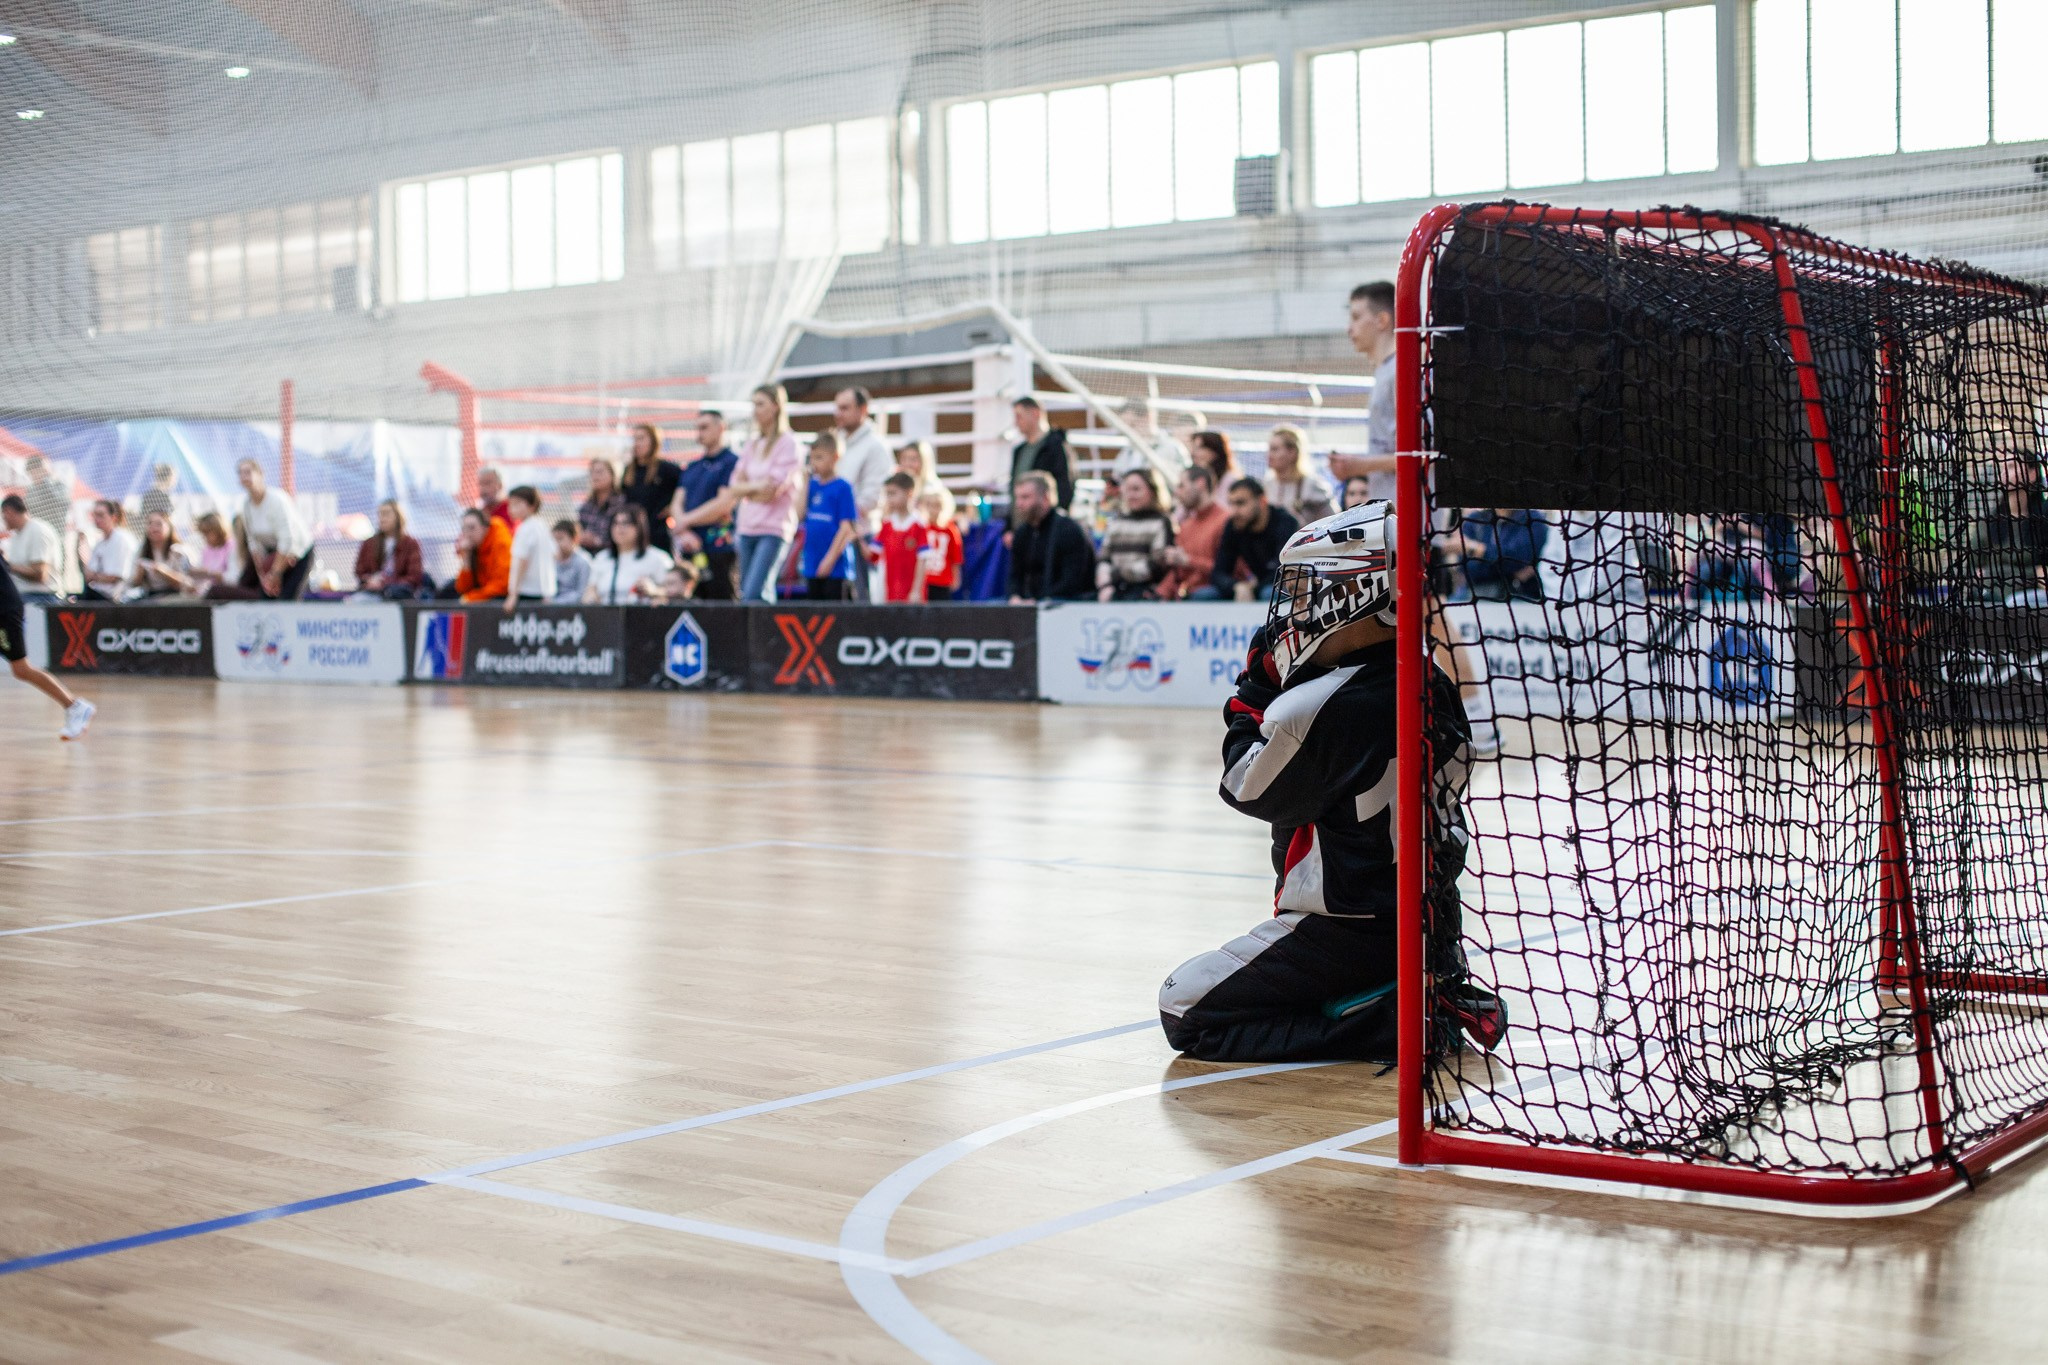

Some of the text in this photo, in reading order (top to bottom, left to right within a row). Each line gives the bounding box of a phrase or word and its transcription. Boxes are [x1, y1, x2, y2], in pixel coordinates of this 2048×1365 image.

[296, 617, 380, 641] МИНСПОРТ
[308, 643, 371, 667] РОССИИ
[837, 635, 1015, 669] OXDOG
